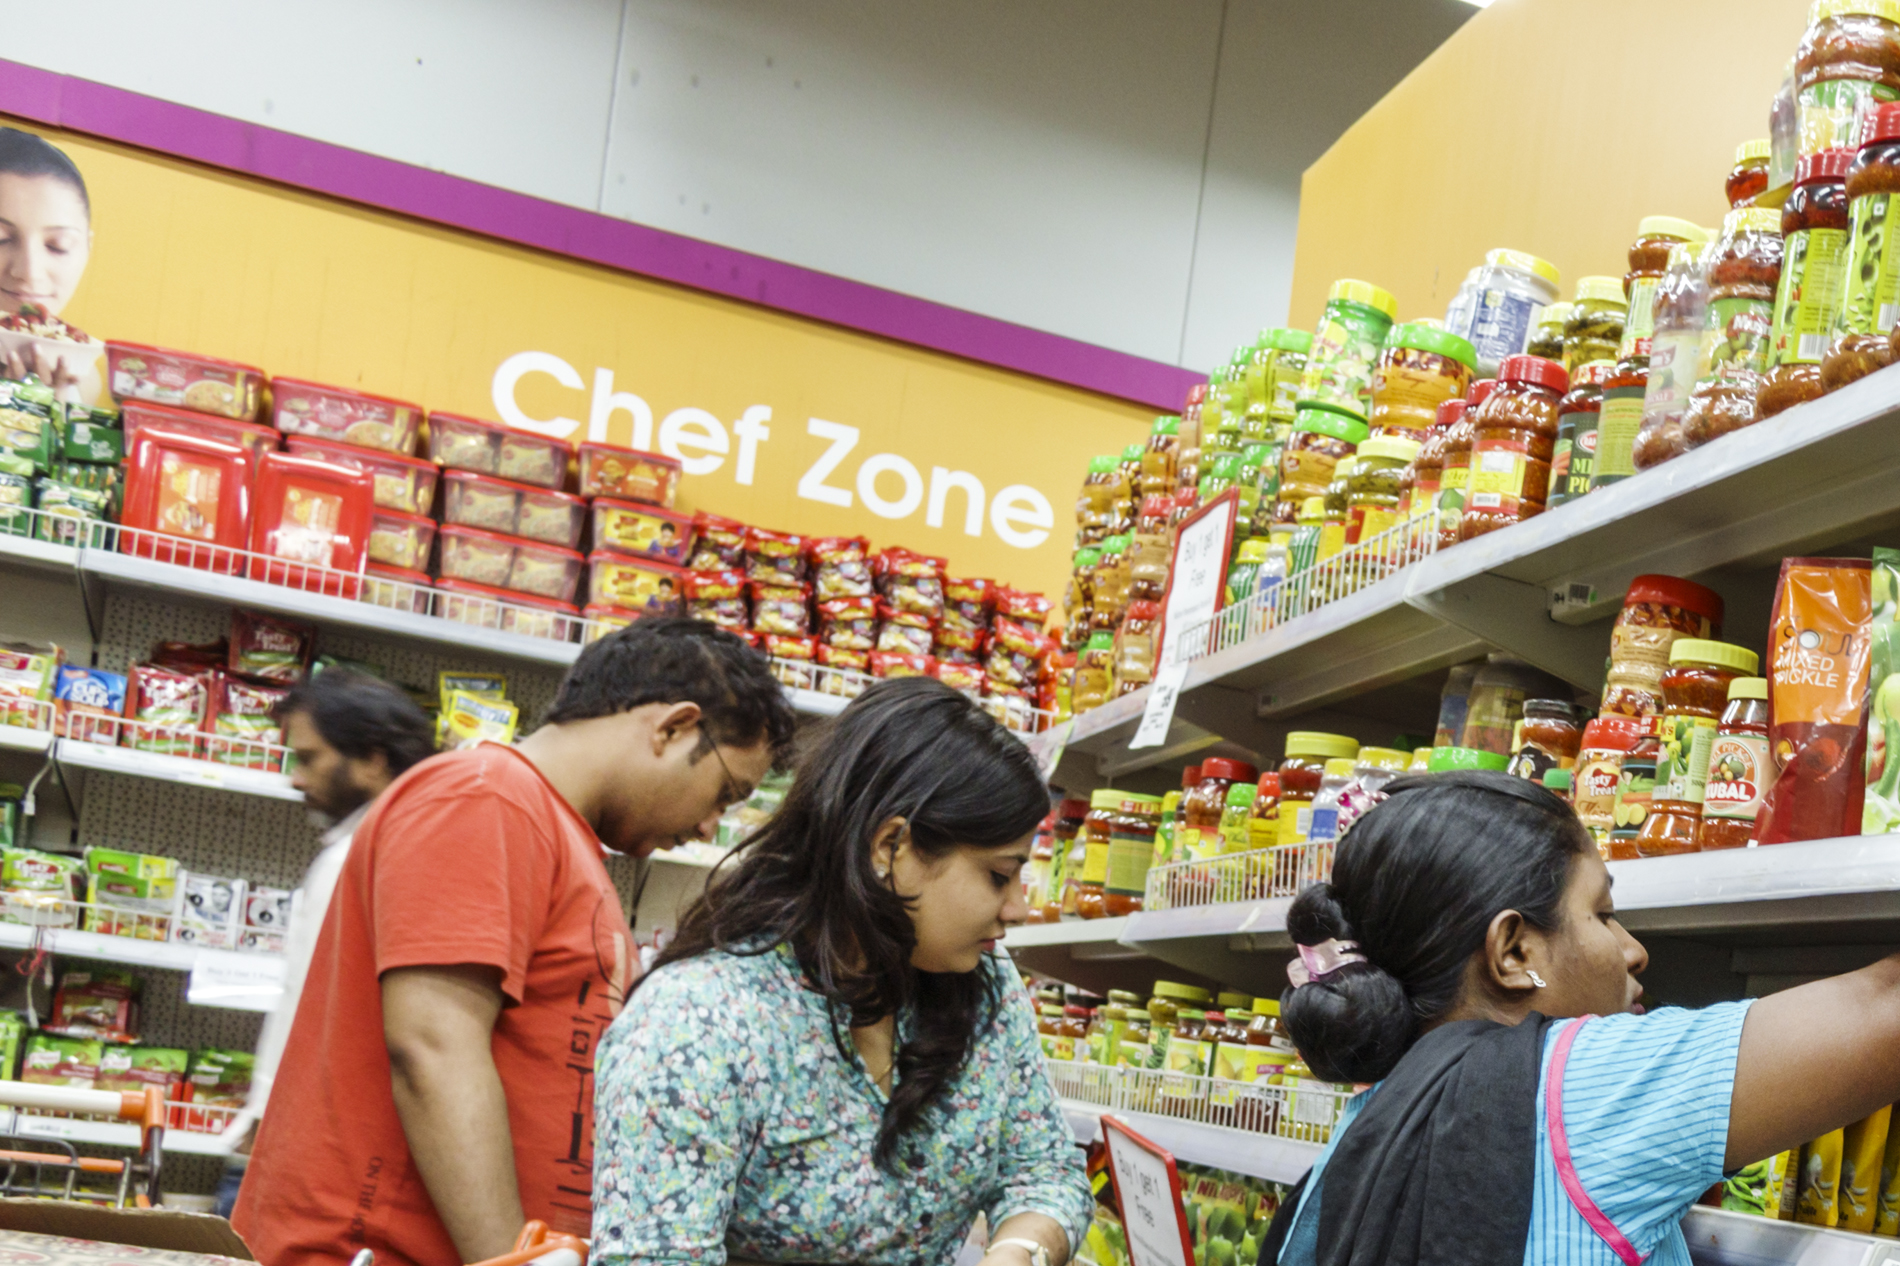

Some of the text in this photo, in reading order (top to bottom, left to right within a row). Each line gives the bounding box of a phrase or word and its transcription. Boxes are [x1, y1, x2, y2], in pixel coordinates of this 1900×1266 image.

[491, 350, 1054, 549] Chef Zone
[1779, 654, 1835, 671] MIXED
[1776, 671, 1839, 689] PICKLE
[1584, 774, 1612, 788] Tasty
[1590, 785, 1617, 797] Treat
[365, 1156, 384, 1179] ON
